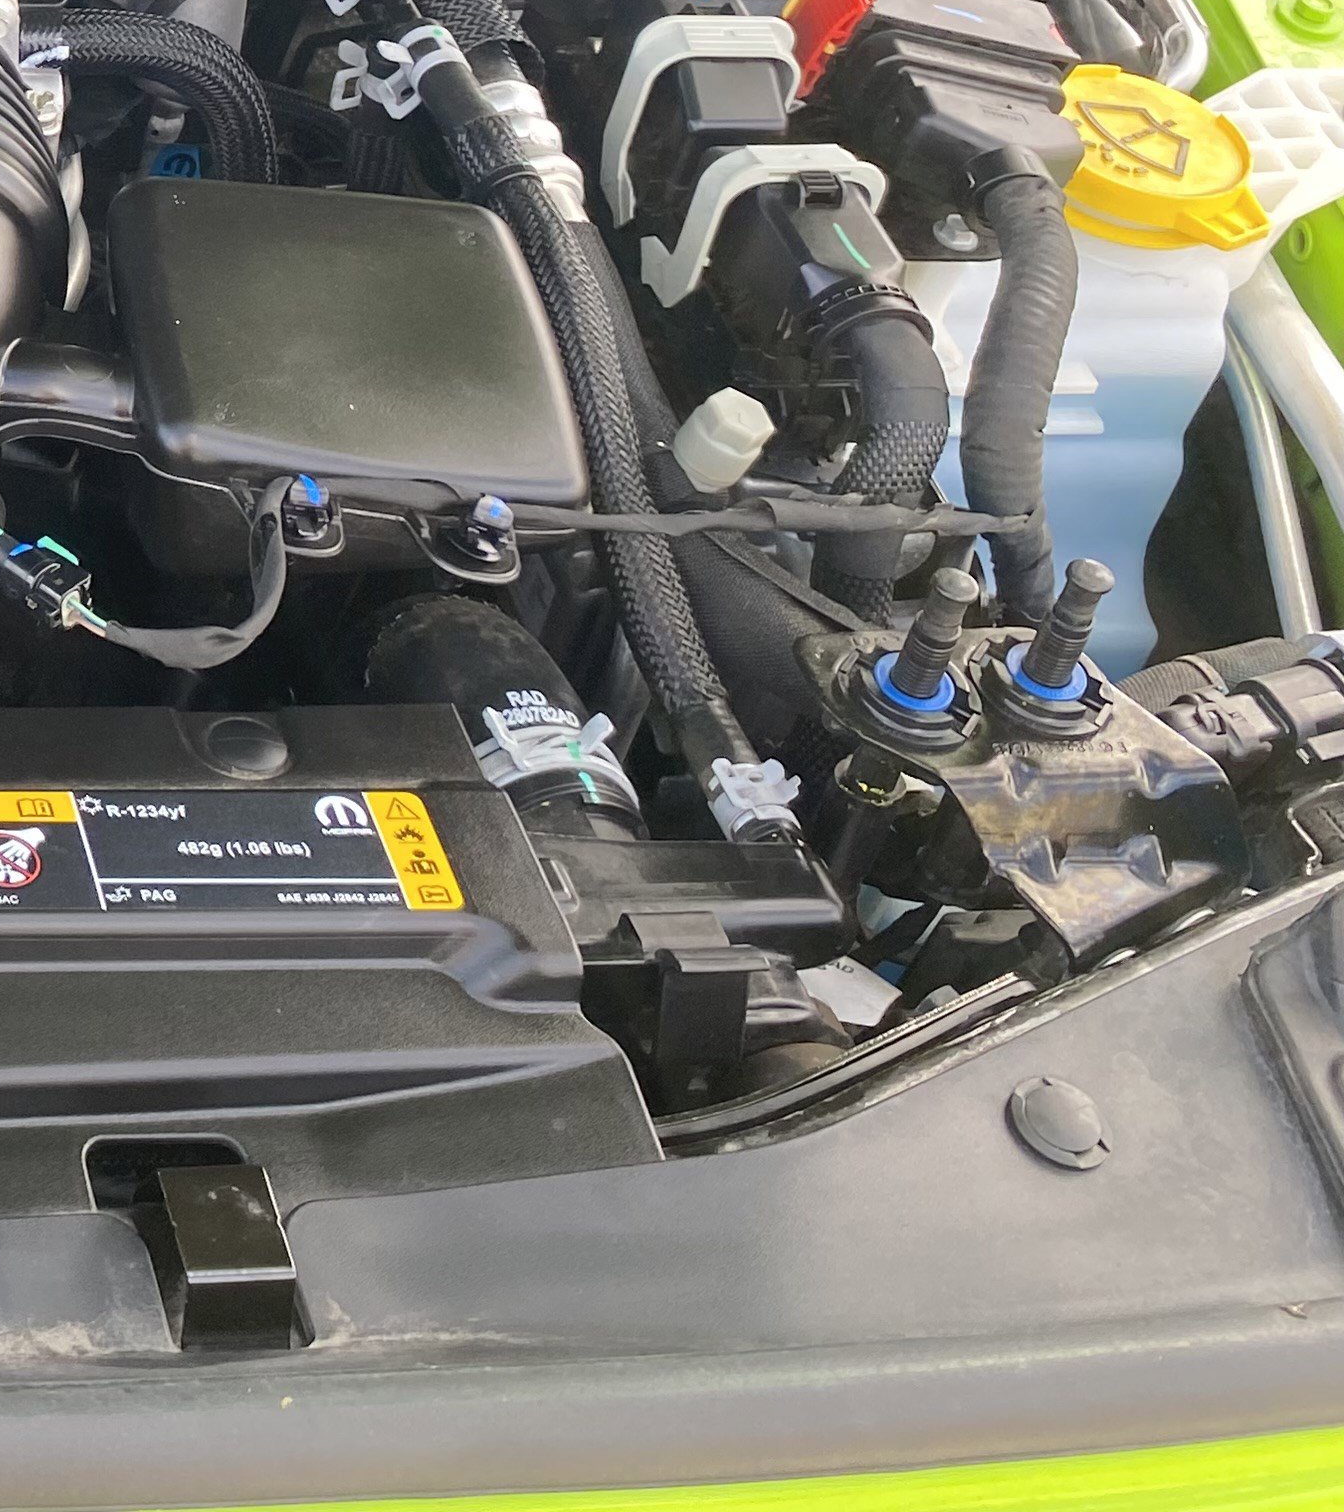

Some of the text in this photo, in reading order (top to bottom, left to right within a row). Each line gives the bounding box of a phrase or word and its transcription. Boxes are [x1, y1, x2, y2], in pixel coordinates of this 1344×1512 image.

[505, 690, 549, 708] RAD
[502, 706, 580, 728] 280782AD
[105, 803, 187, 821] R-1234yf
[177, 841, 312, 859] 482g (1.06 lbs)
[140, 888, 177, 902] PAG
